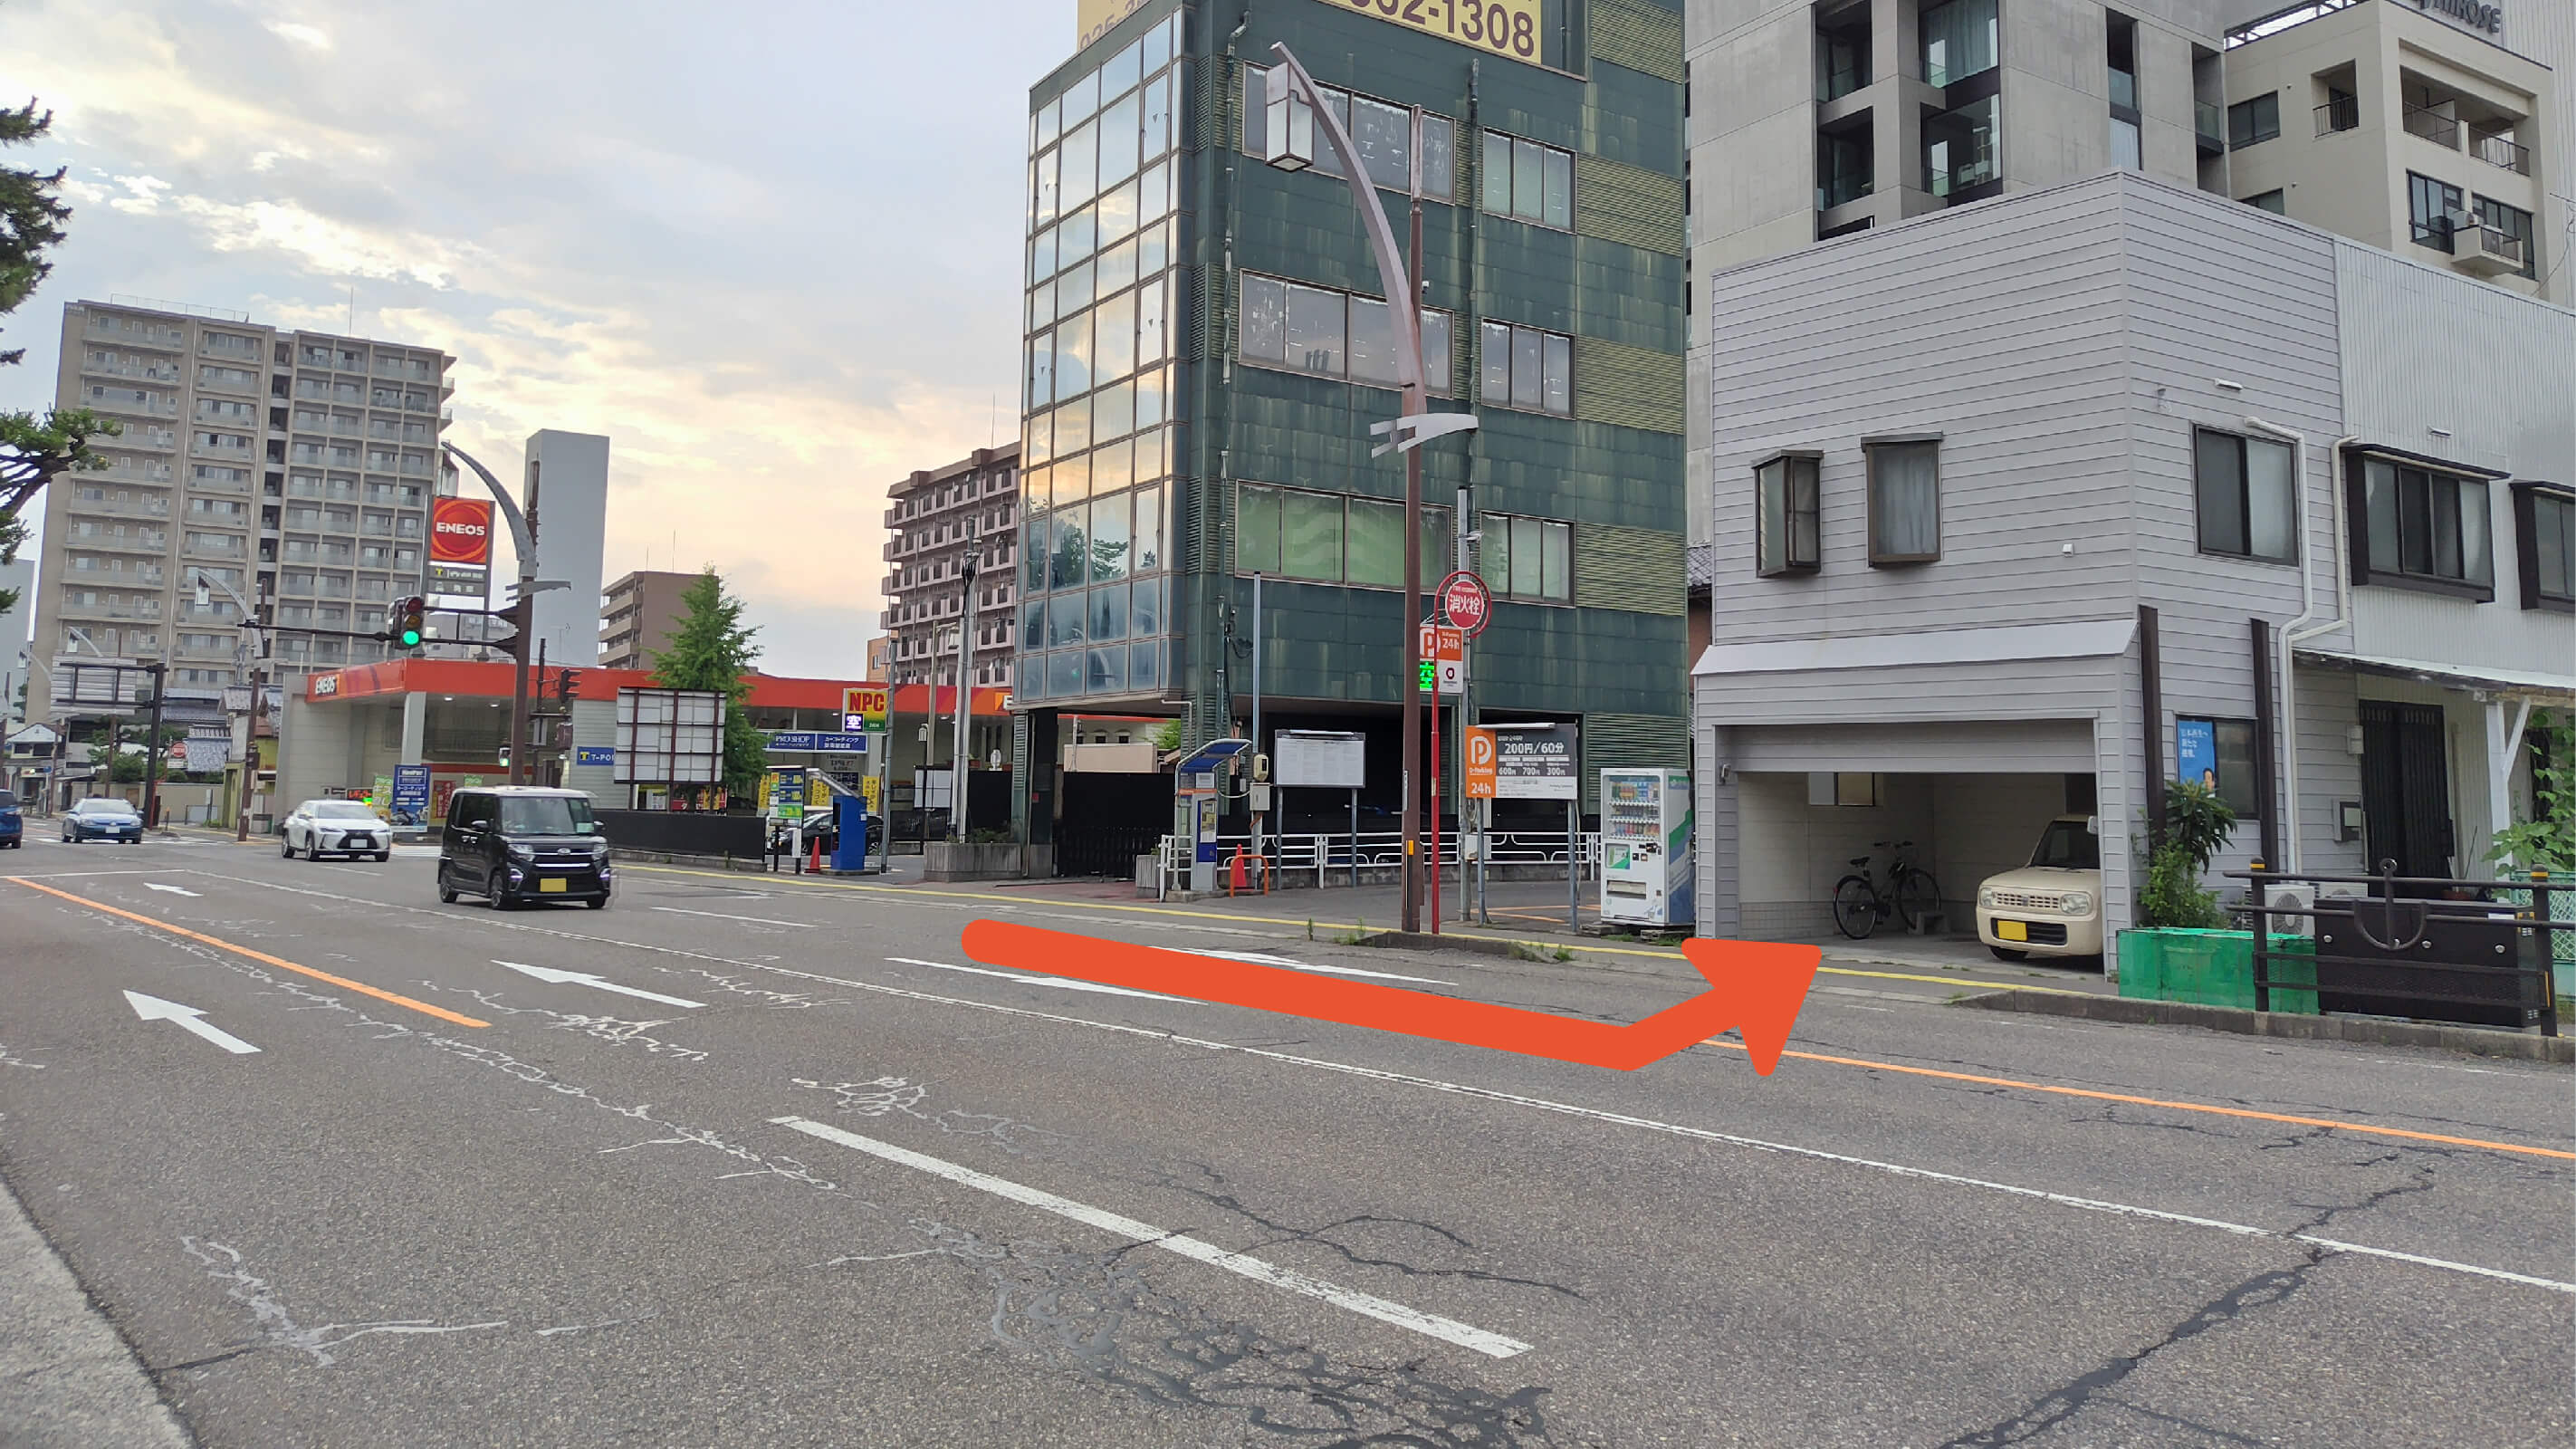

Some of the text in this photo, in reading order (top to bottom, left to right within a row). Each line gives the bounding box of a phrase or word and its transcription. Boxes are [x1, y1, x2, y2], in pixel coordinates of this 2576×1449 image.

[1350, 0, 1534, 57] 2-1308
[436, 522, 485, 536] ENEOS
[1449, 594, 1480, 616] 消火栓
[1442, 638, 1460, 651] 24h
[849, 693, 885, 712] NPC
[1470, 782, 1491, 795] 24h
